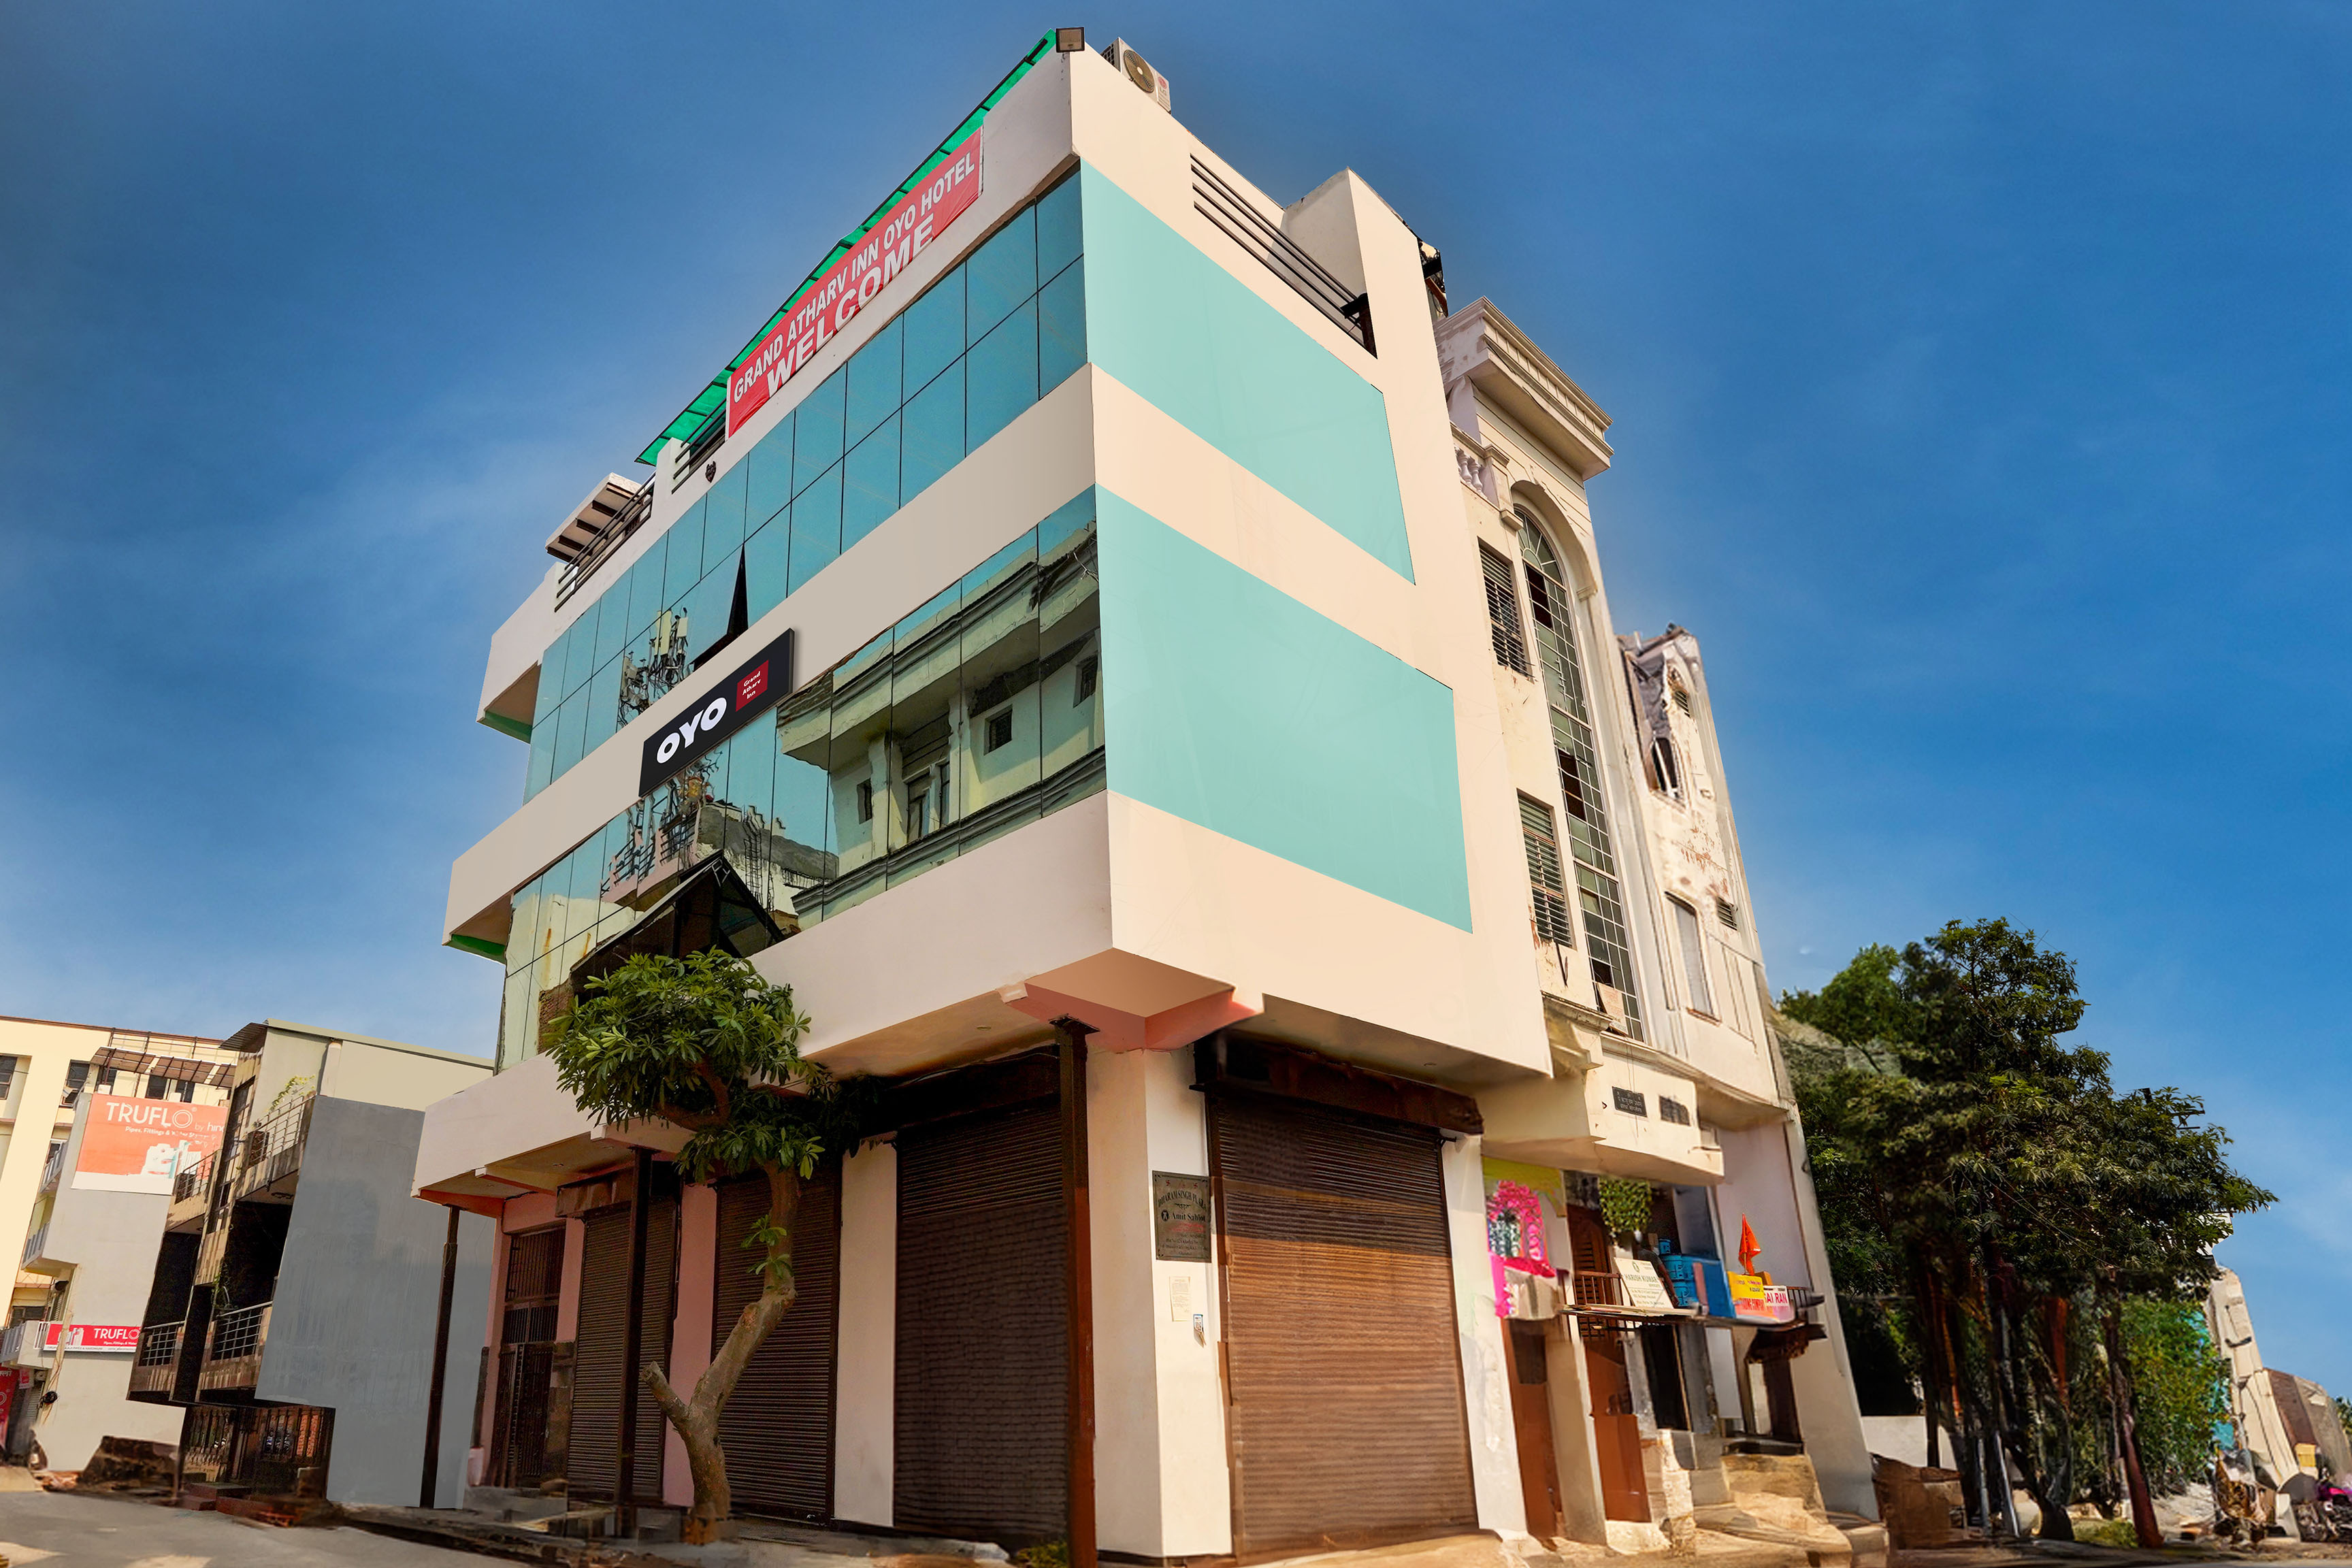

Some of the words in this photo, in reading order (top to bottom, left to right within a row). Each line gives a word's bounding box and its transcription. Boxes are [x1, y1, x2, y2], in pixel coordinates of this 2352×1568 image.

[734, 333, 783, 404] GRAND
[786, 266, 849, 348] ATHARV
[851, 237, 879, 282] INN
[883, 204, 915, 251] OYO
[920, 151, 975, 217] HOTEL
[766, 212, 935, 399] WELCOME
[742, 679, 762, 696] Atharv
[743, 670, 761, 687] Grand
[747, 689, 756, 700] Inn
[656, 697, 728, 764] OYO
[106, 1102, 193, 1129] TRUFLO
[195, 1123, 204, 1132] by
[93, 1328, 140, 1340] TRUFLO
